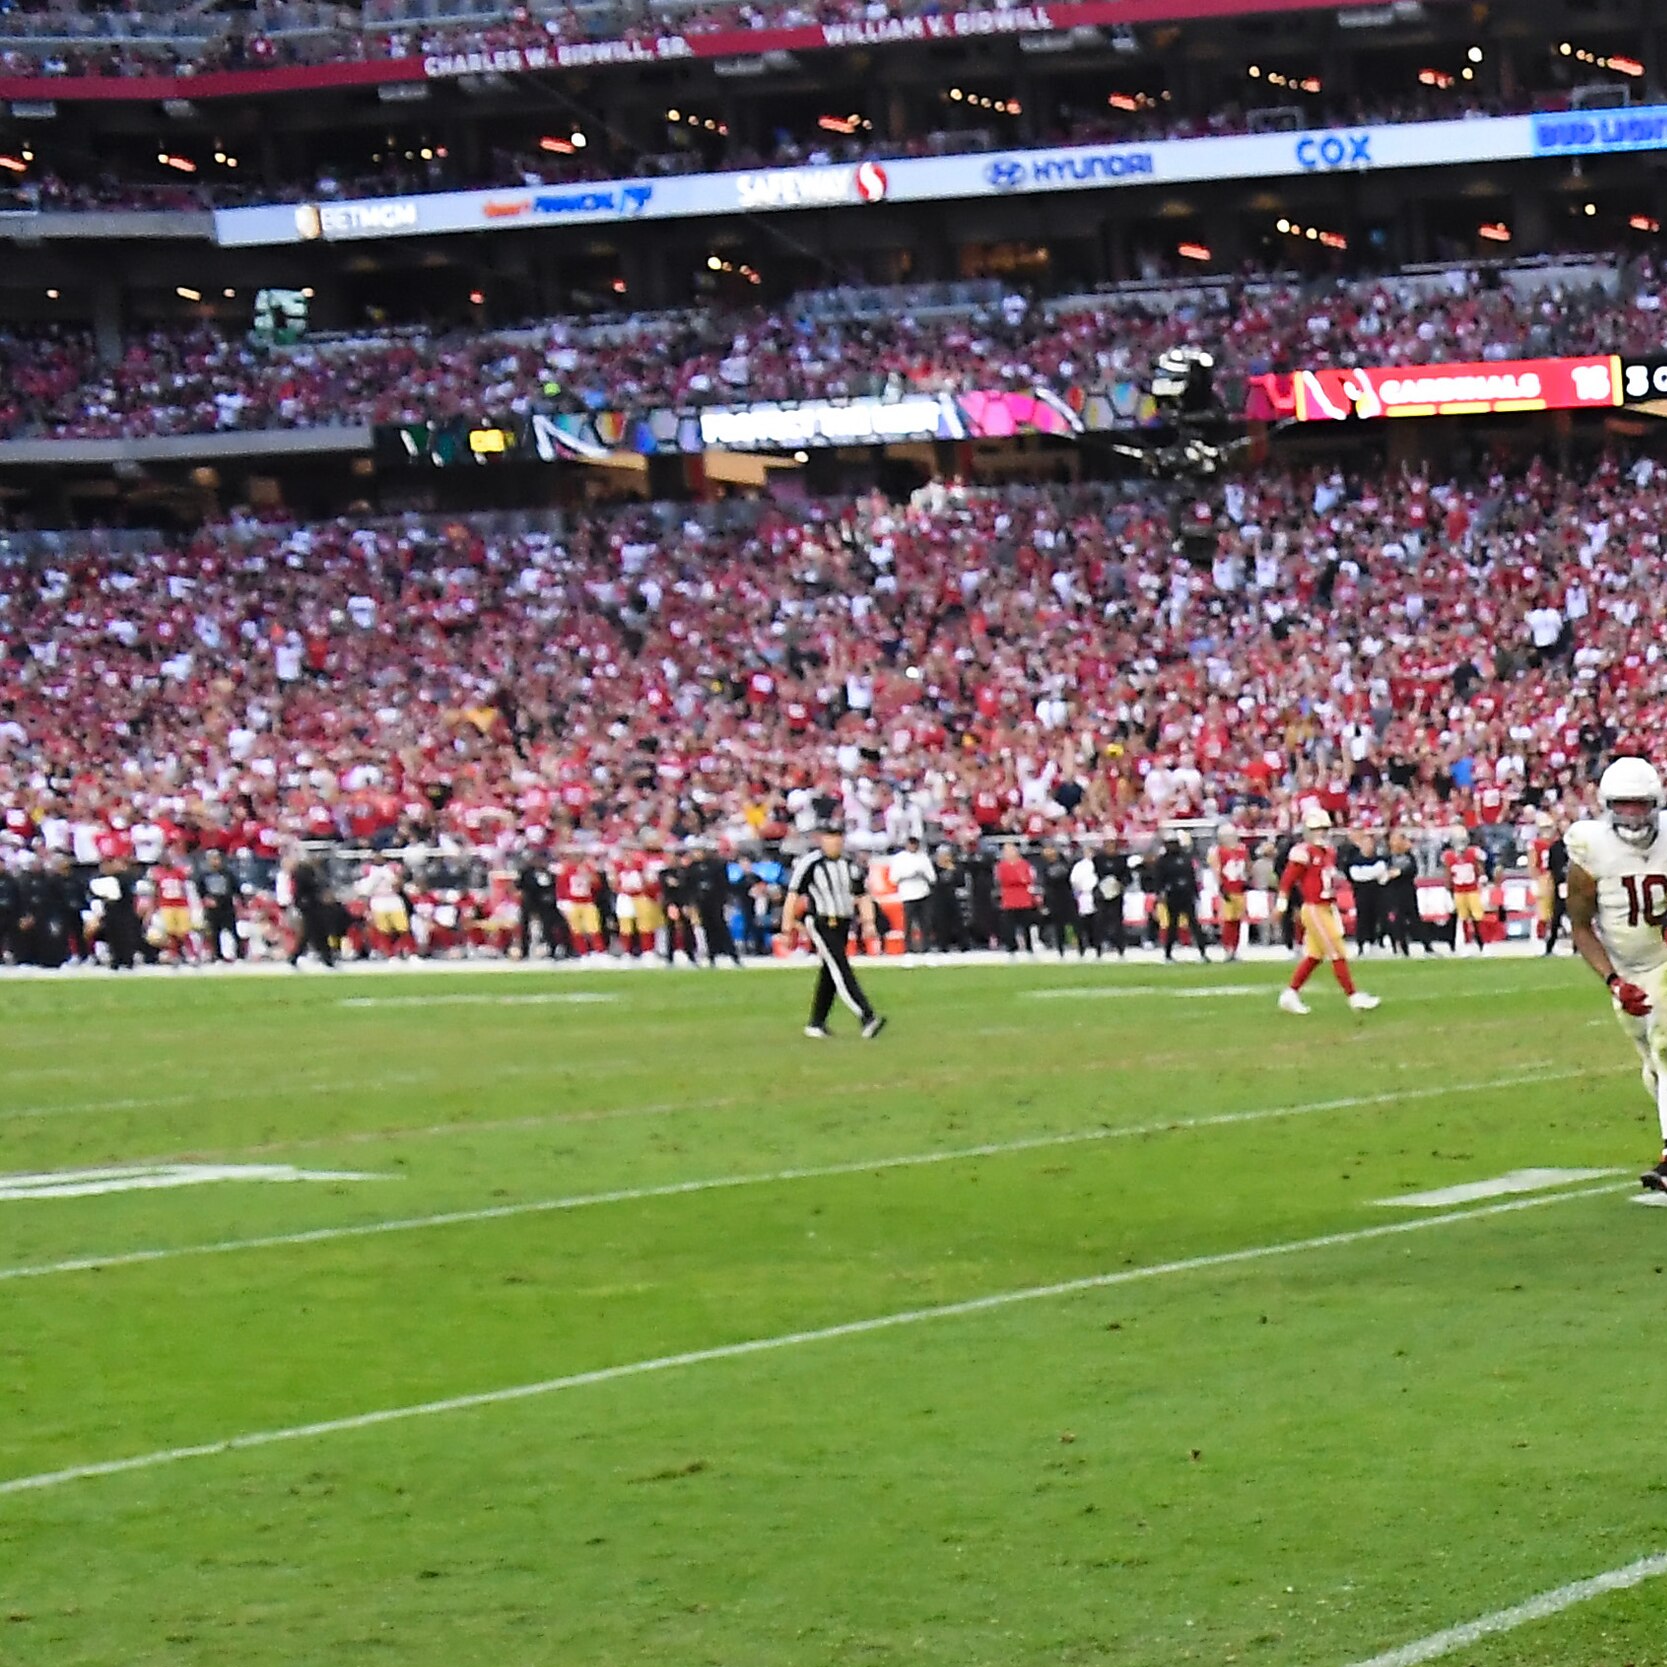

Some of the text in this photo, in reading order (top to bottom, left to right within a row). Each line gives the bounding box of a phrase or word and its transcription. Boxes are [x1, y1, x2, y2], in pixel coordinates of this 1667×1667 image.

[424, 50, 522, 77] CHARLES
[1296, 135, 1370, 167] COX
[1033, 153, 1152, 180] HYUNDAI
[735, 169, 852, 208] SAFEWAY
